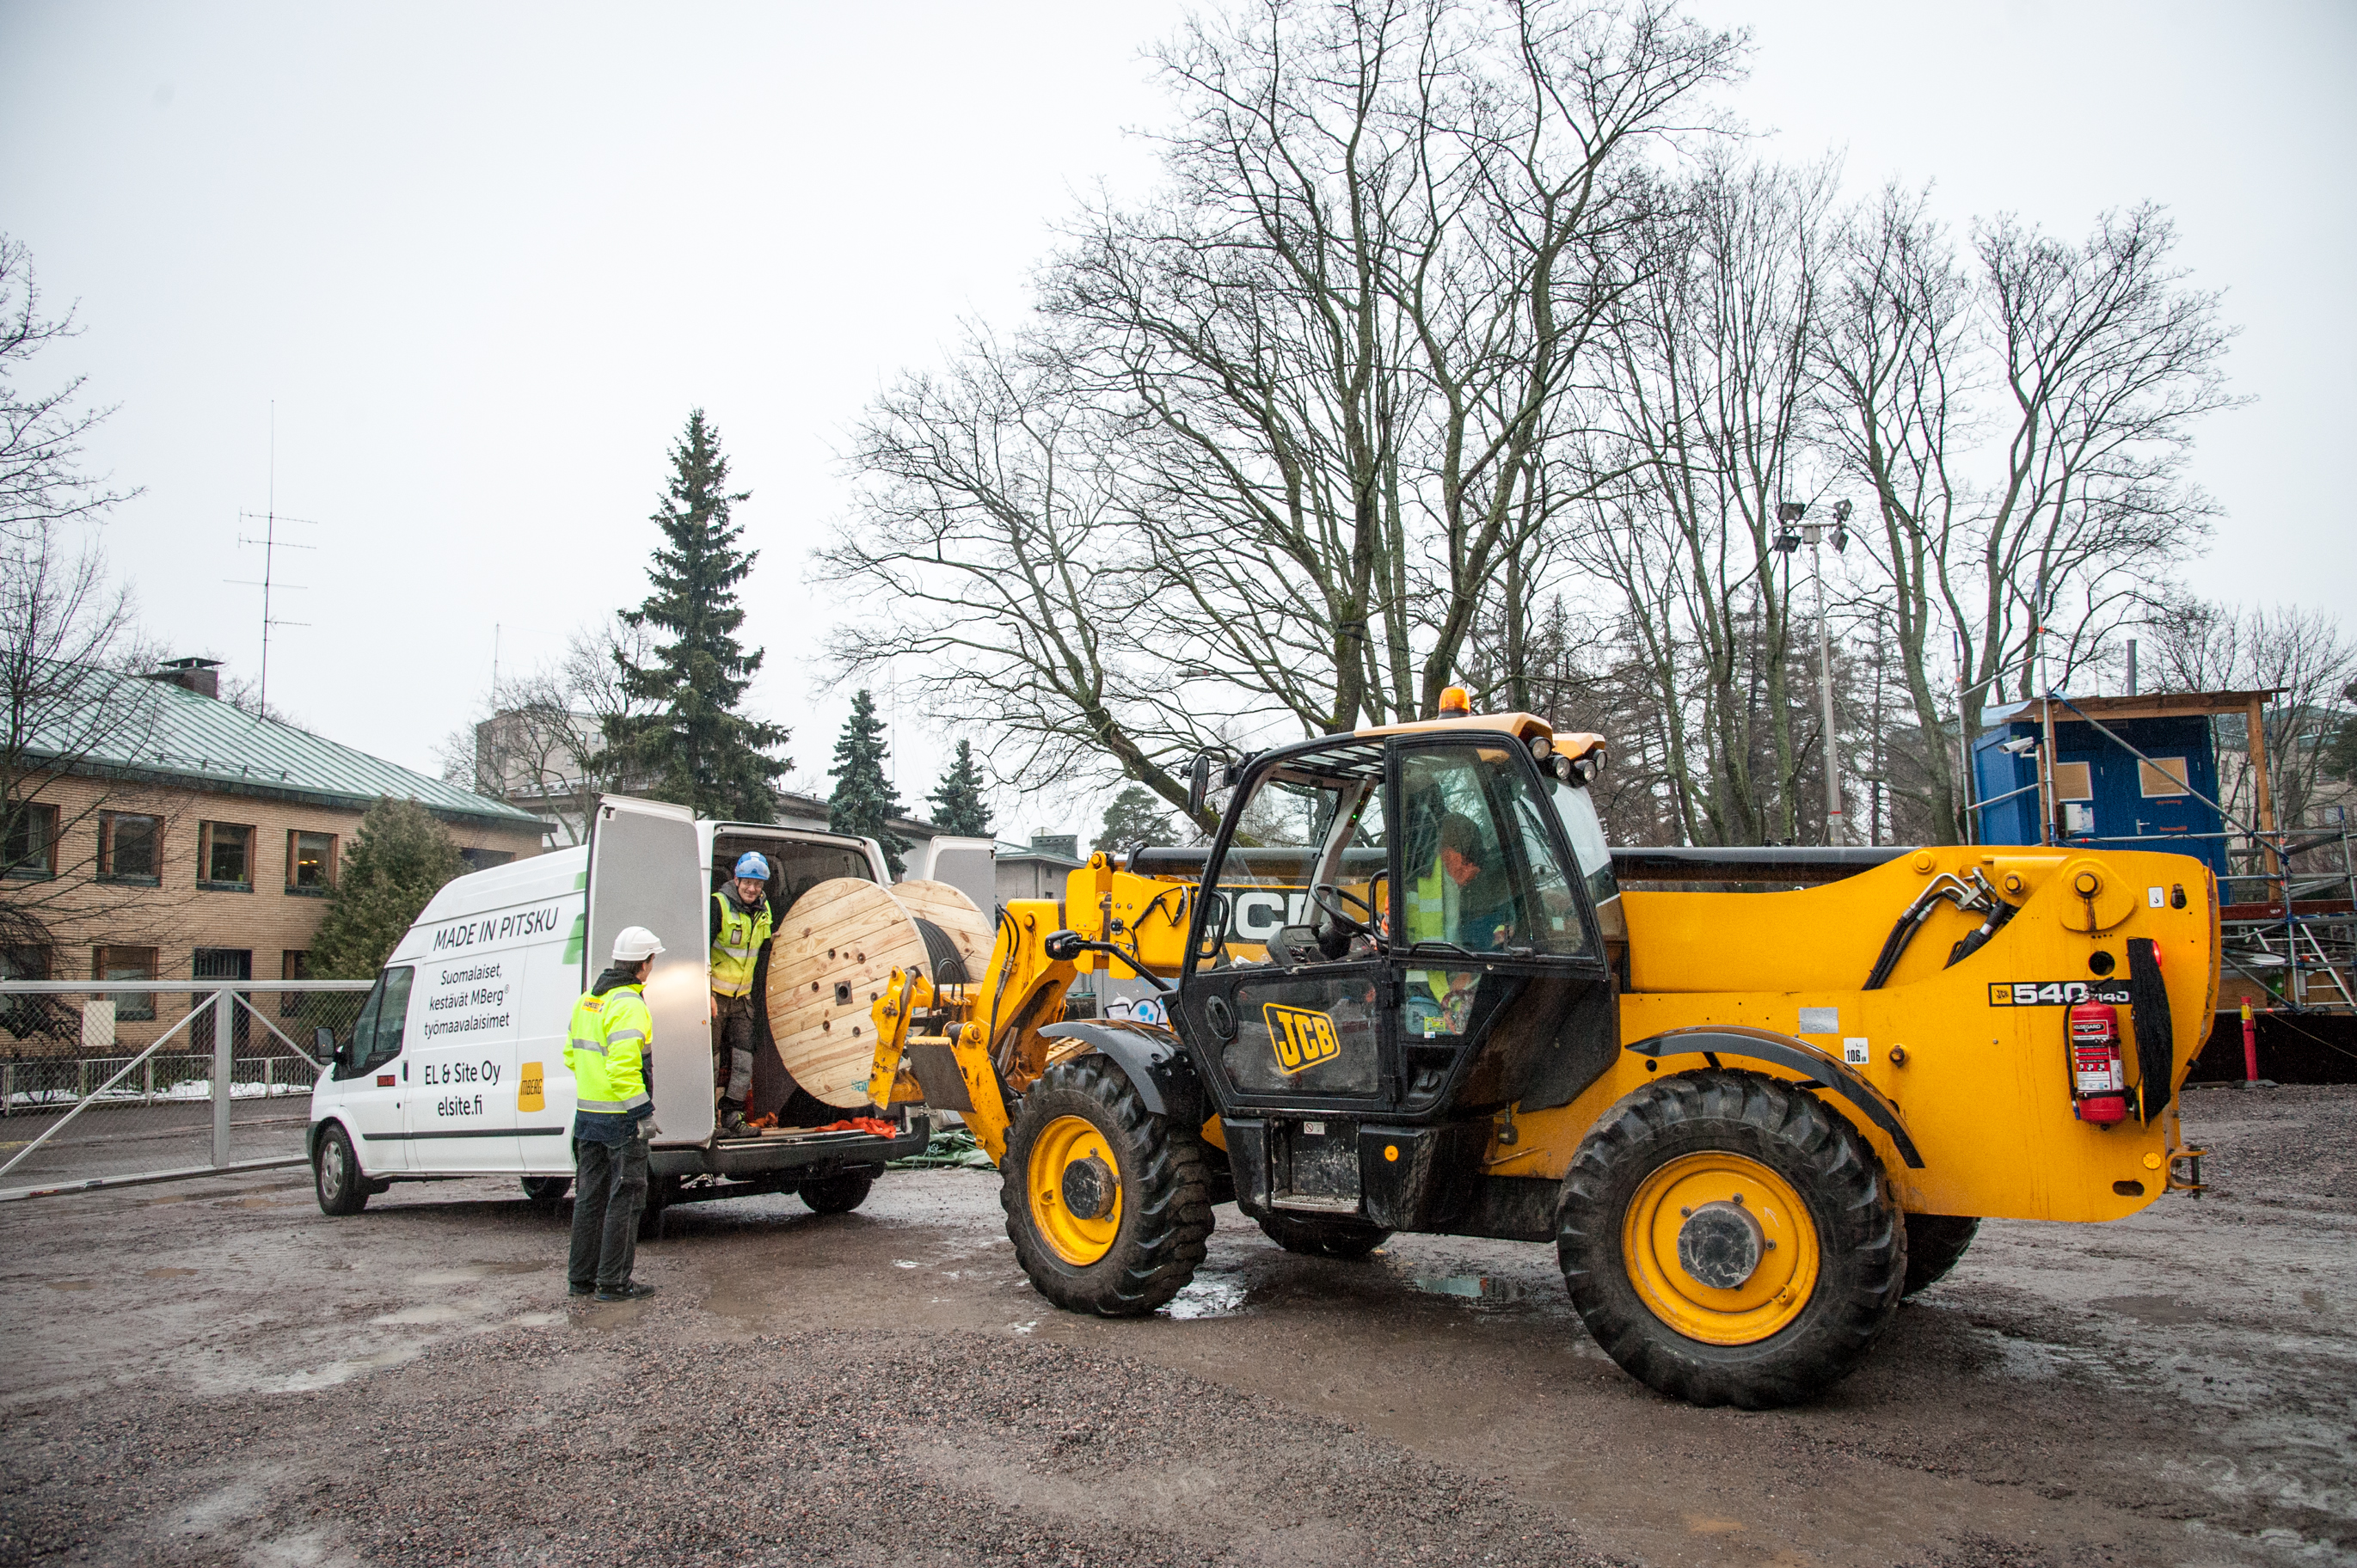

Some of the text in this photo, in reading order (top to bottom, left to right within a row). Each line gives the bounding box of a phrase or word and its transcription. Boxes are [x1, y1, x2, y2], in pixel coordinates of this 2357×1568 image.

[433, 907, 559, 952] MADE IN PITSKU
[440, 963, 502, 985] Suomalaiset,
[429, 991, 469, 1011] kestävät
[2013, 982, 2088, 1004] 540
[424, 1012, 510, 1039] työmaavalaisimet
[1276, 1010, 1335, 1067] JCB
[1846, 1049, 1861, 1063] 106
[425, 1060, 501, 1086] EL & Site Oy
[520, 1078, 543, 1096] MBERG
[437, 1094, 483, 1117] elsite.fi
